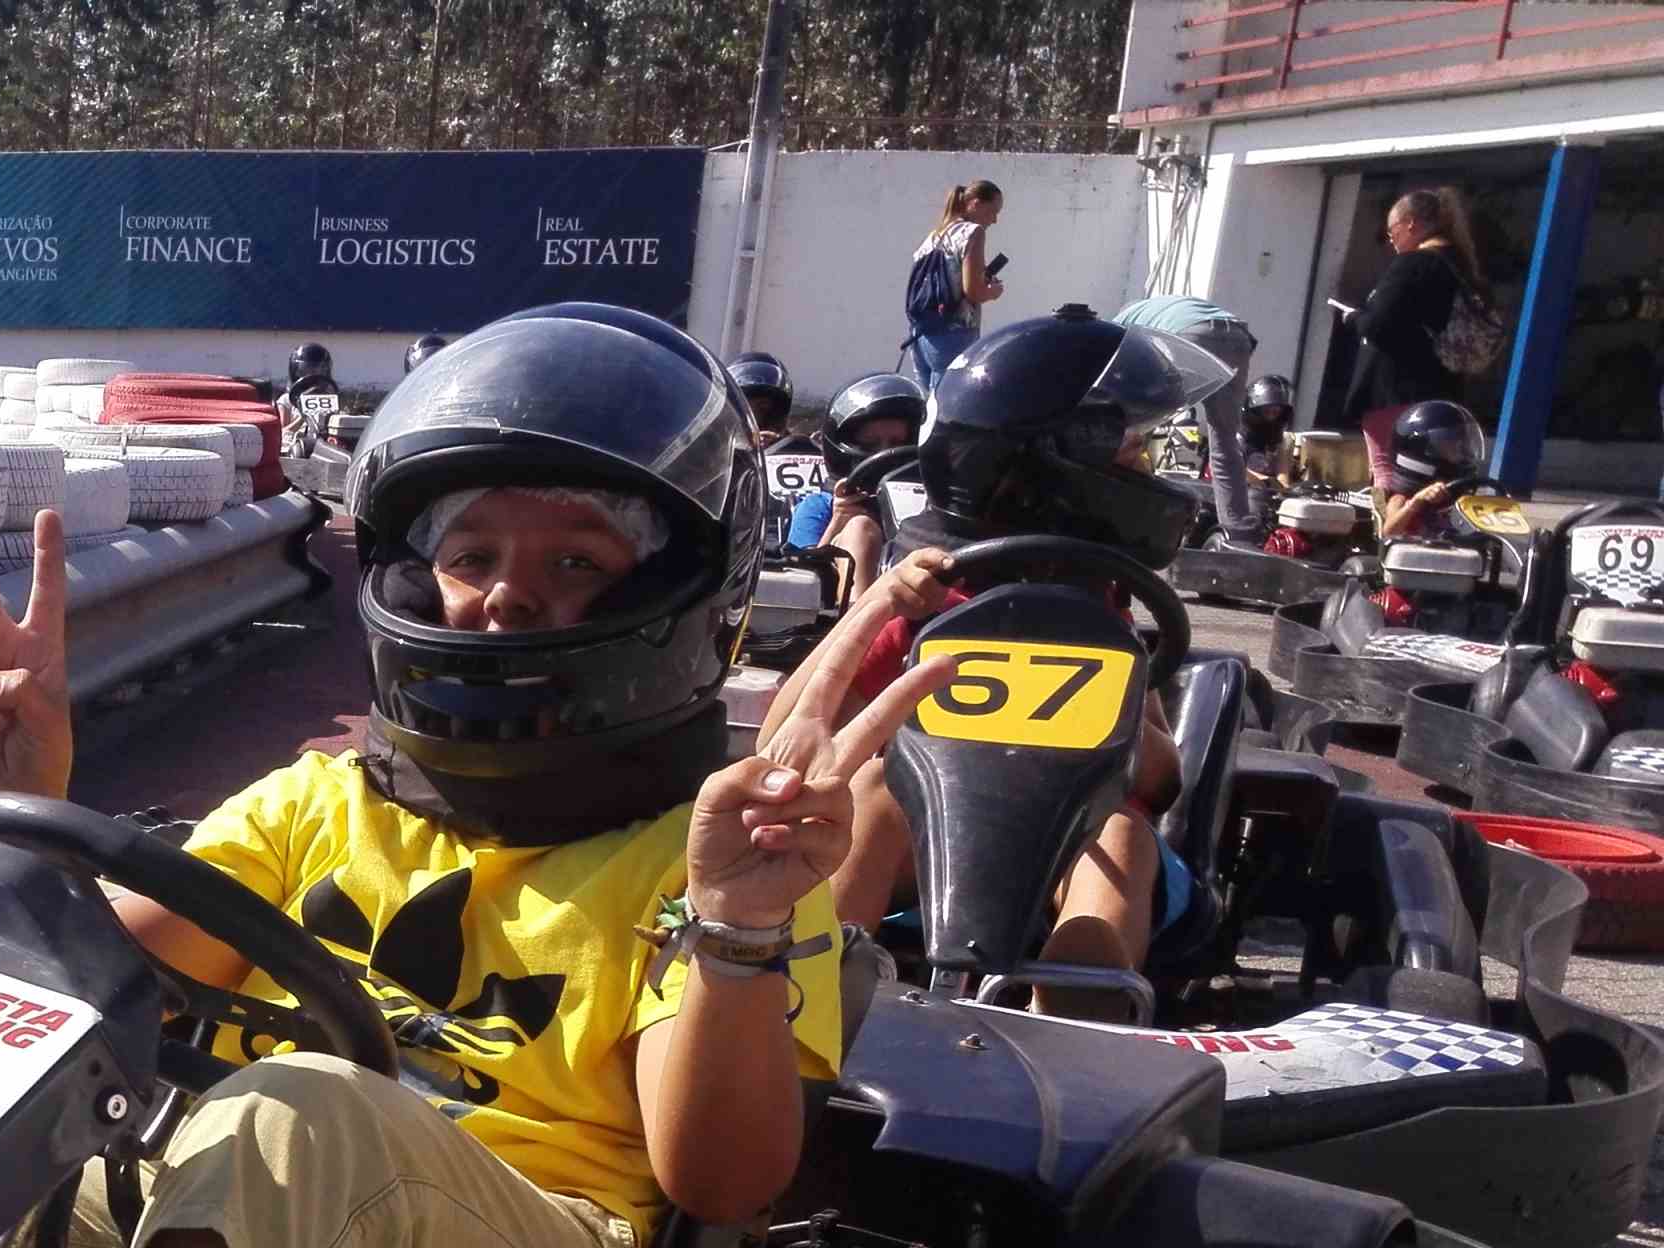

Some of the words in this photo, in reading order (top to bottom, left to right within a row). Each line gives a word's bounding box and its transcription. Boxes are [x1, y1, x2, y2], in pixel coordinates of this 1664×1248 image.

[126, 215, 213, 230] CORPORATE
[321, 216, 389, 231] BUSINESS
[545, 217, 584, 231] REAL
[126, 236, 252, 263] FINANCE
[320, 238, 476, 265] LOGISTICS
[544, 238, 660, 265] ESTATE
[305, 397, 332, 410] 68
[776, 462, 824, 489] 64
[1598, 534, 1655, 572] 69
[932, 651, 1104, 721] 67
